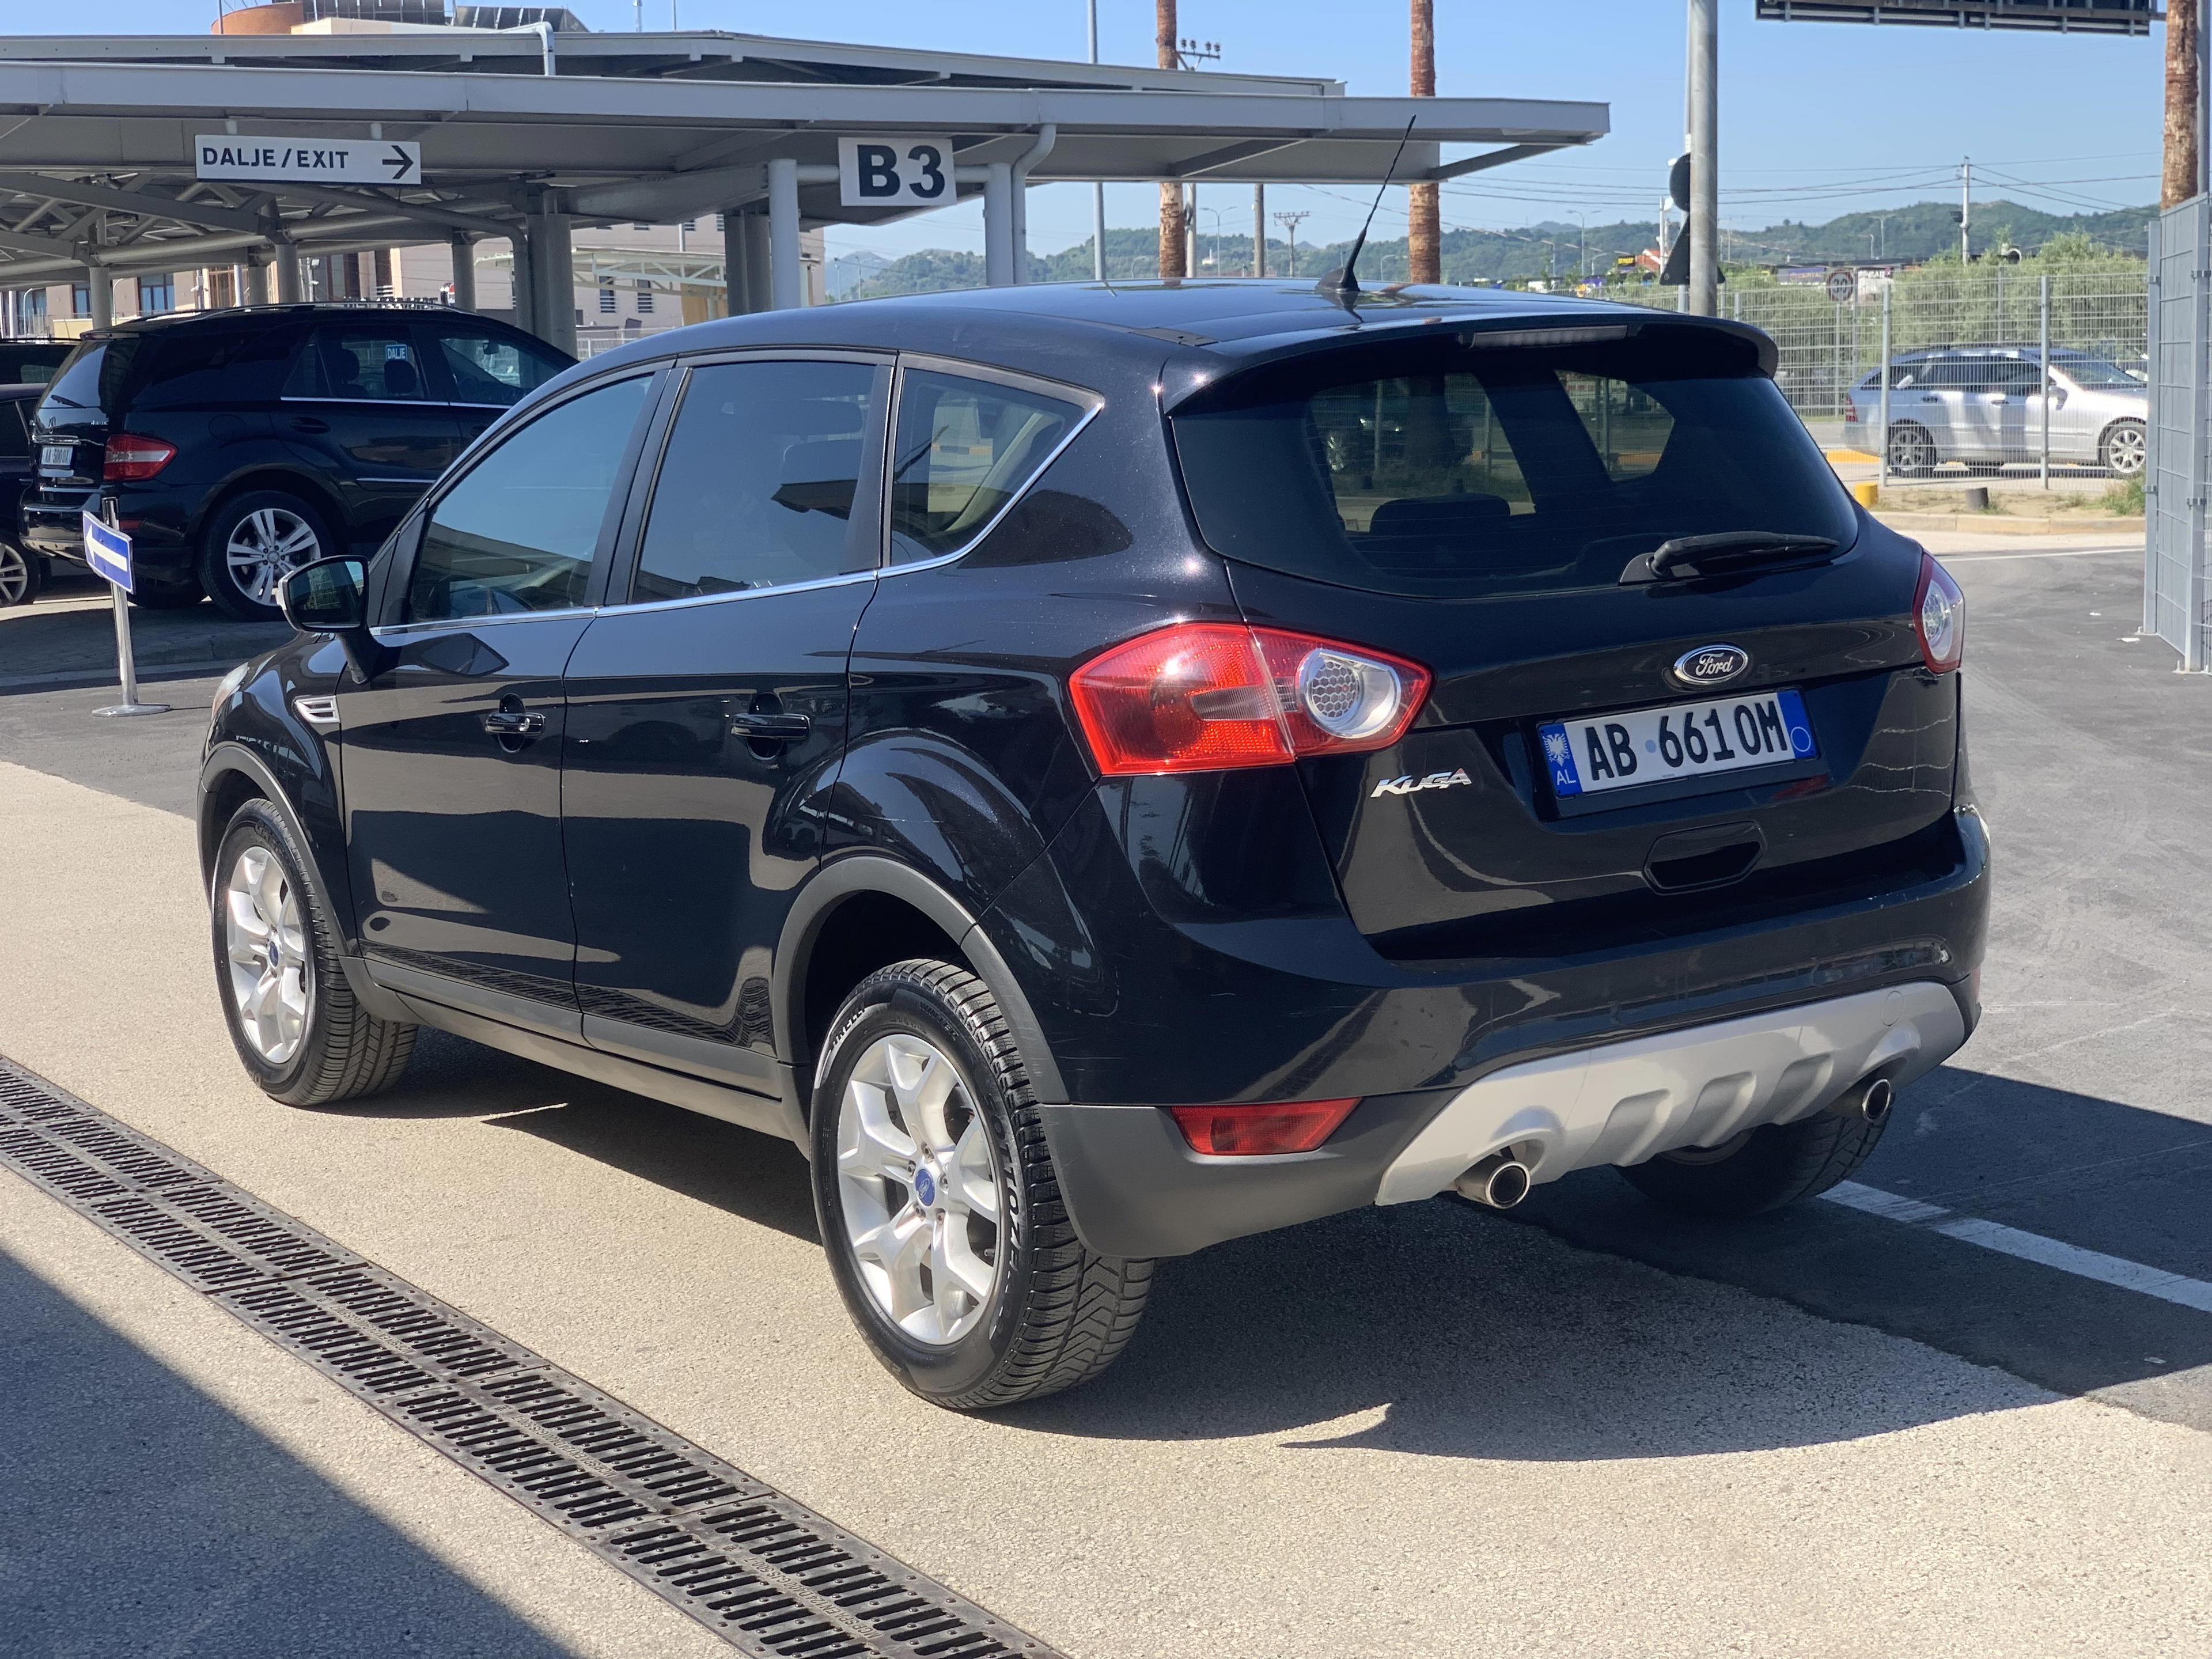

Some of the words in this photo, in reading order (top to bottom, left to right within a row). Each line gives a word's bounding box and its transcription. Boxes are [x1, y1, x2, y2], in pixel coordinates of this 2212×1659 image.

[857, 145, 945, 198] B3
[387, 348, 406, 359] DALJE
[1695, 652, 1733, 676] Ford
[1585, 724, 1637, 781] AB
[1370, 768, 1472, 798] KUGA
[1556, 770, 1577, 786] AL
